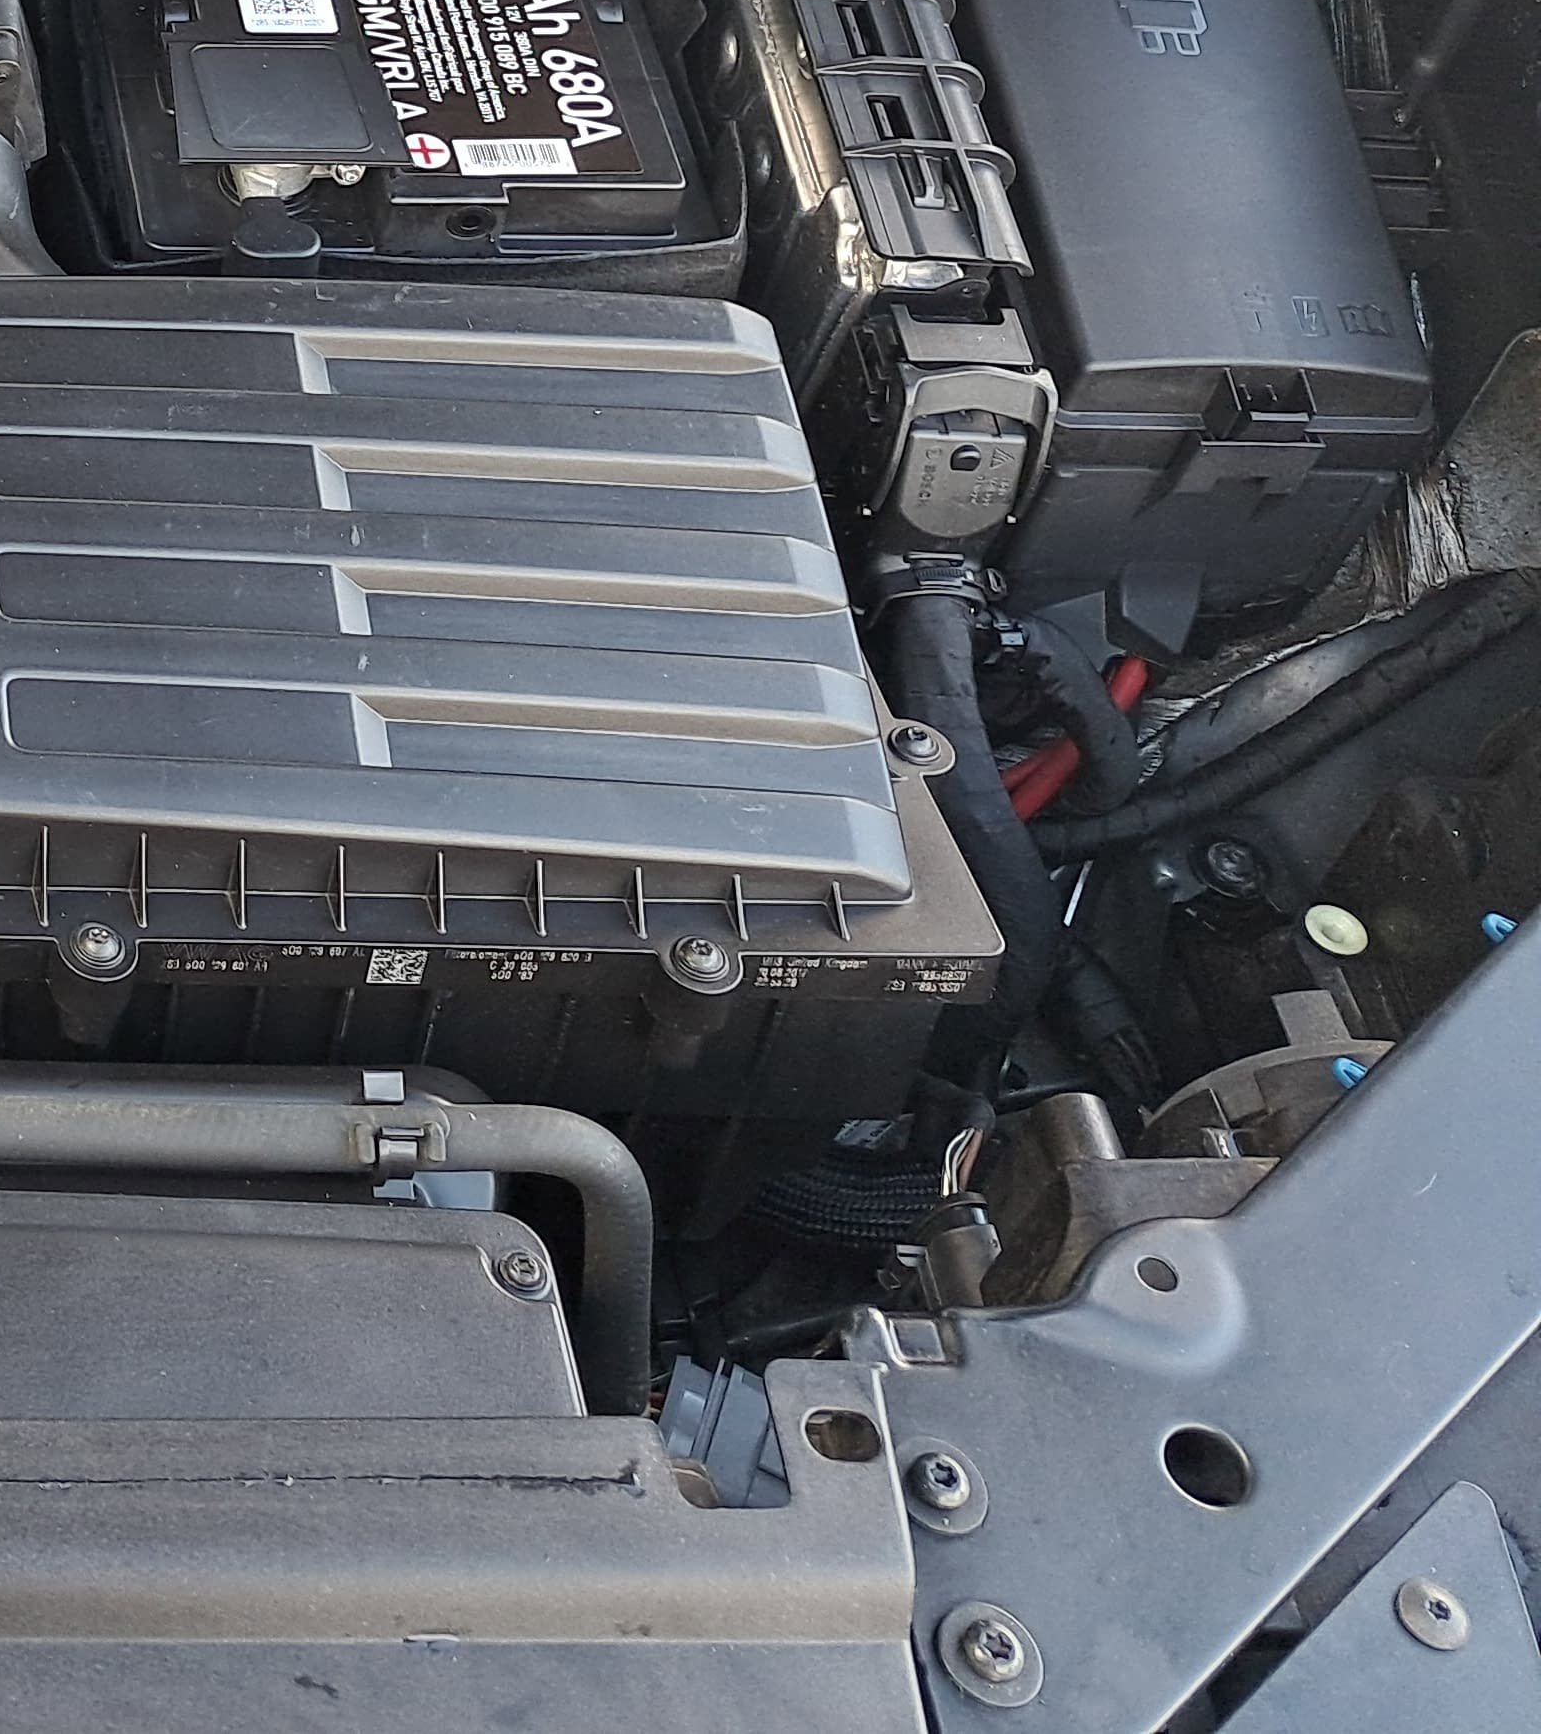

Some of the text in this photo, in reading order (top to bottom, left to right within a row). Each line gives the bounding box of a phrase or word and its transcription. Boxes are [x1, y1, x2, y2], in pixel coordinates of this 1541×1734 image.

[483, 16, 509, 41] 915
[504, 5, 541, 77] 12V 380A DIN
[493, 45, 519, 70] 089
[503, 73, 528, 95] BC
[541, 49, 622, 147] 680A
[826, 958, 868, 971] Kingdom
